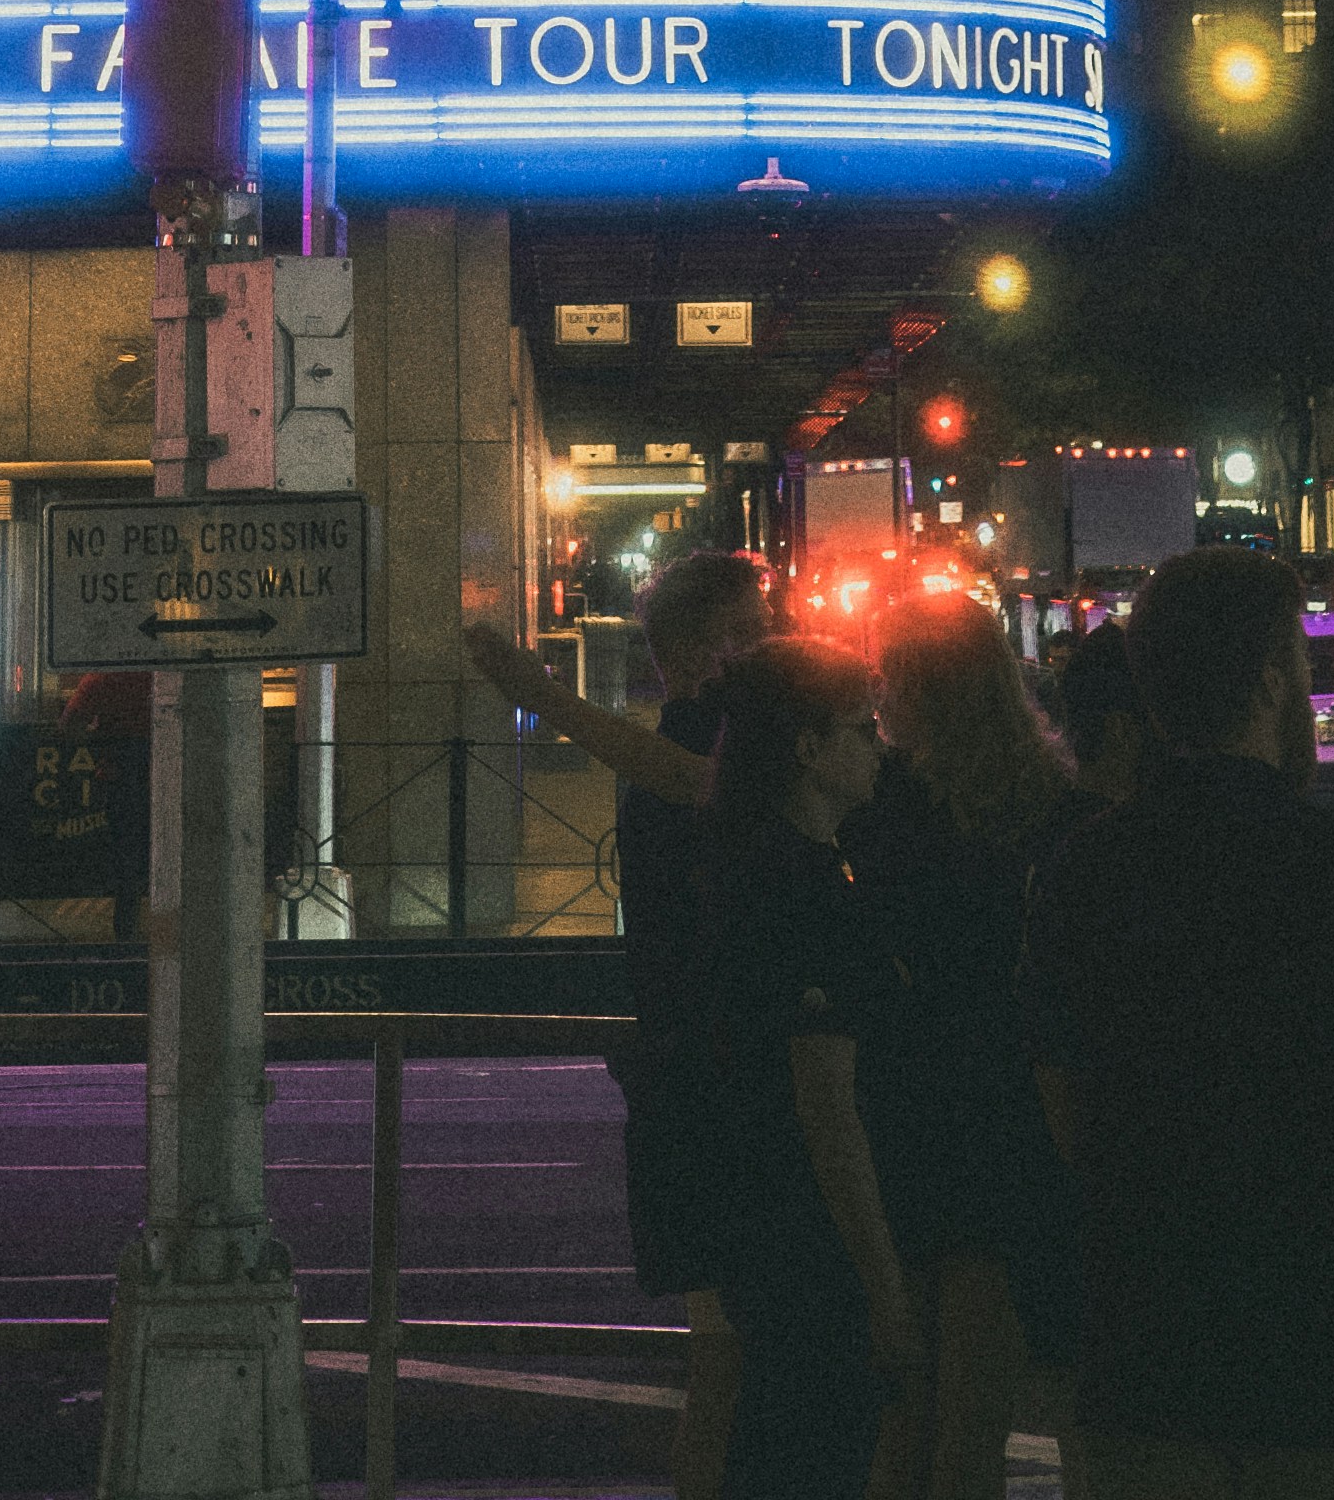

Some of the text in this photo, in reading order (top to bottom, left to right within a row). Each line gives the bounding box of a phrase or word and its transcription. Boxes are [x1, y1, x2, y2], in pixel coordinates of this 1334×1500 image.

[473, 15, 709, 87] TOUR
[827, 19, 1069, 98] TONIGHT
[67, 526, 105, 557] NO
[200, 518, 349, 552] CROSSING
[80, 565, 335, 604] USE CROSSWALK
[71, 979, 125, 1011] DO
